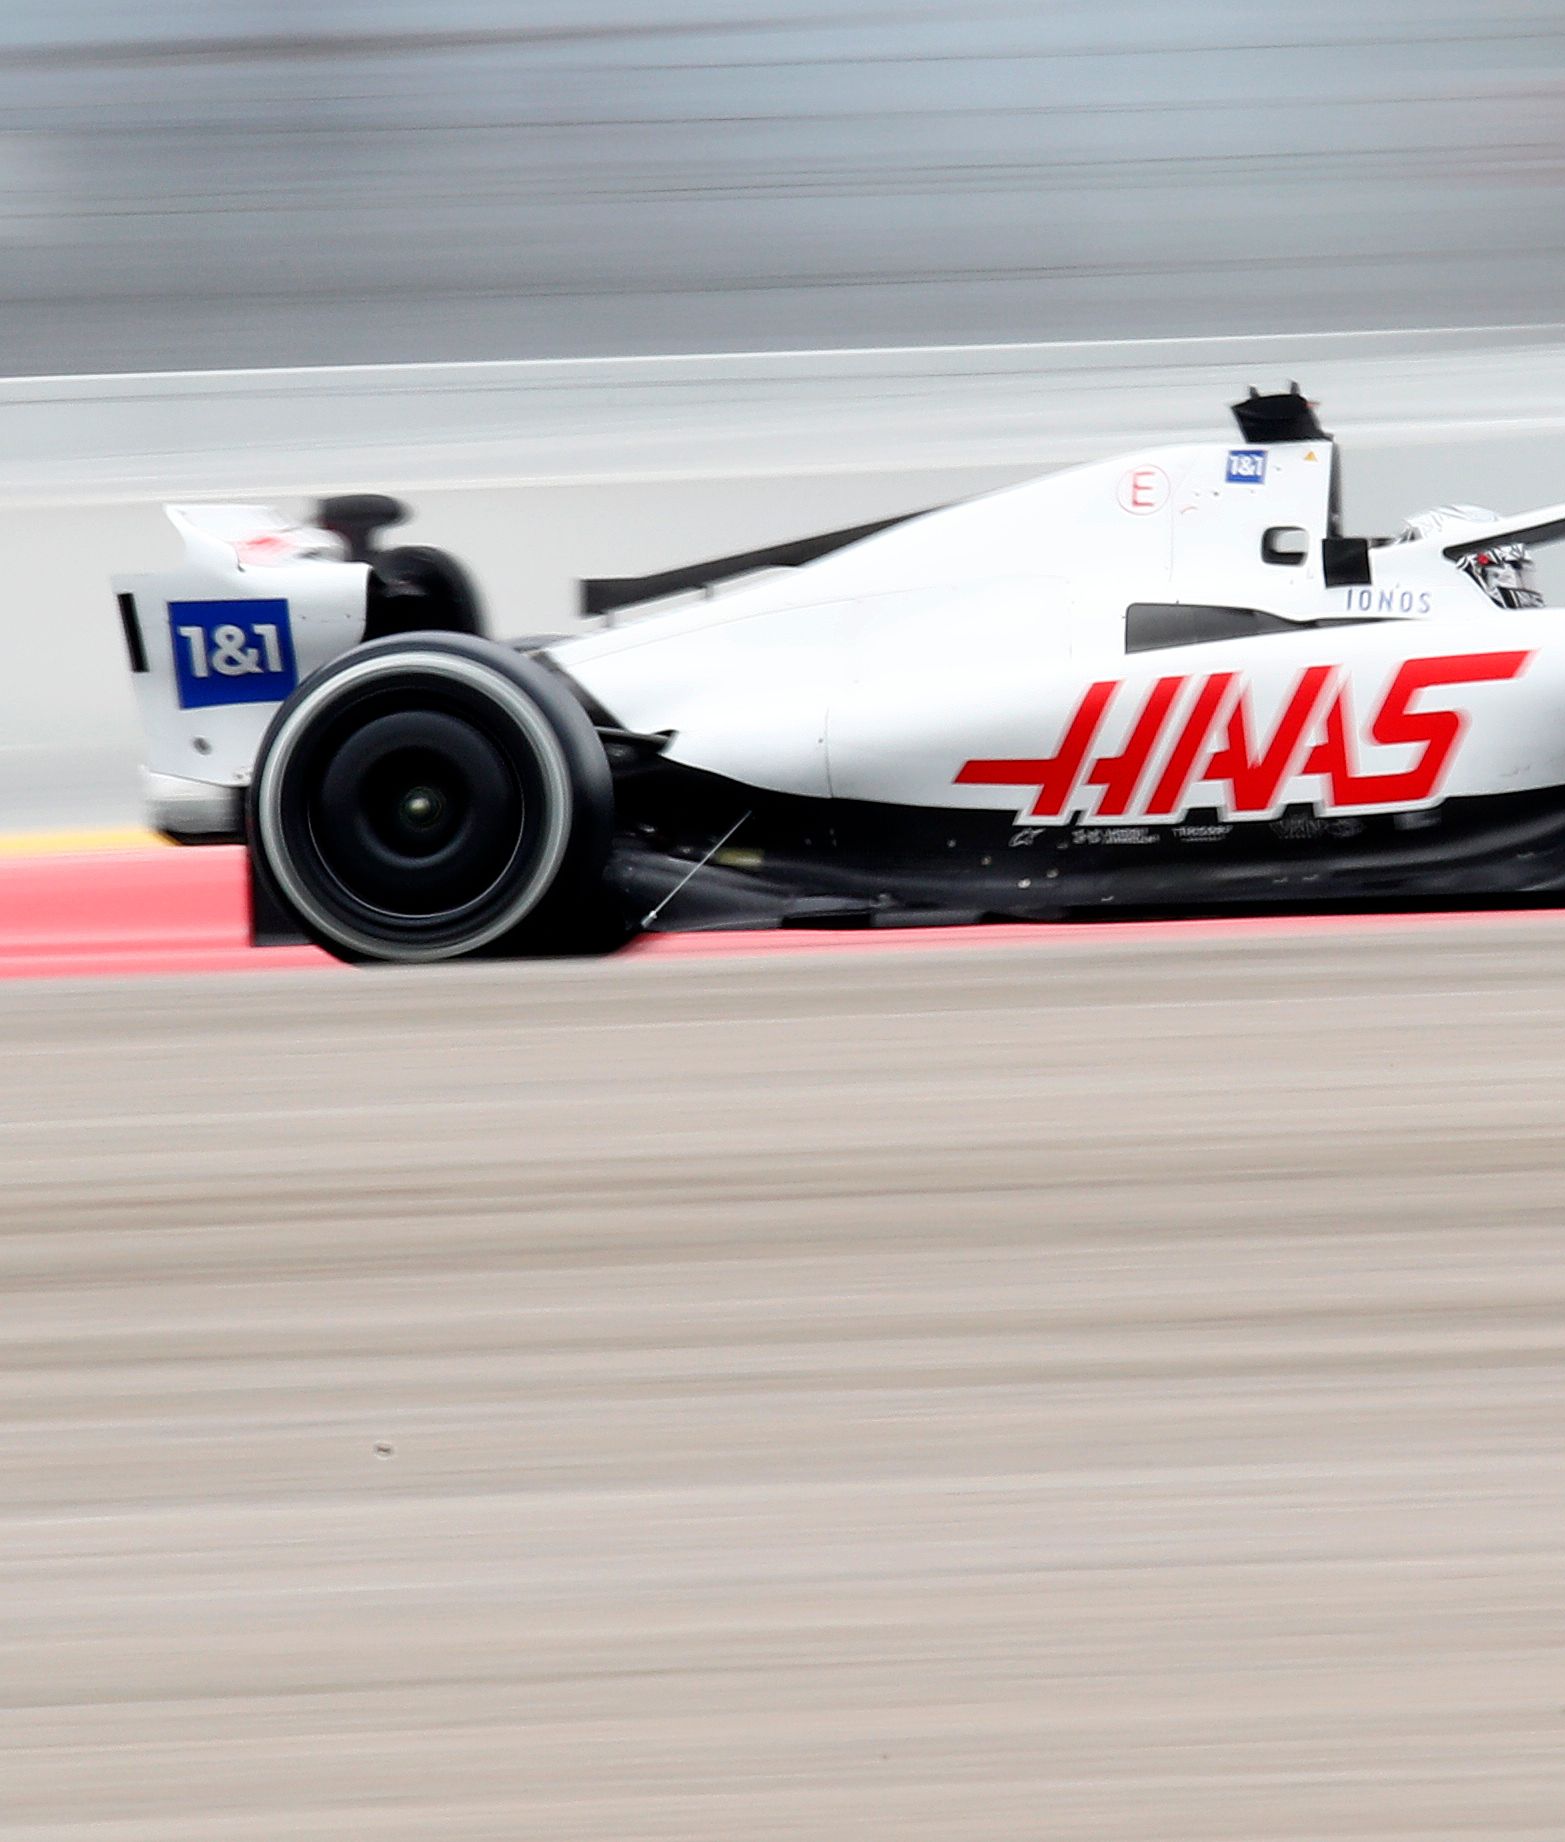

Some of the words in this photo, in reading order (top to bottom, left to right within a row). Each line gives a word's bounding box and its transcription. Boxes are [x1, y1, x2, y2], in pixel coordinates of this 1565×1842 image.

[1230, 454, 1263, 476] 1&1
[1132, 471, 1155, 507] E
[1346, 588, 1431, 614] IONOS
[177, 624, 284, 678] 1&1
[953, 650, 1533, 816] HAAS
